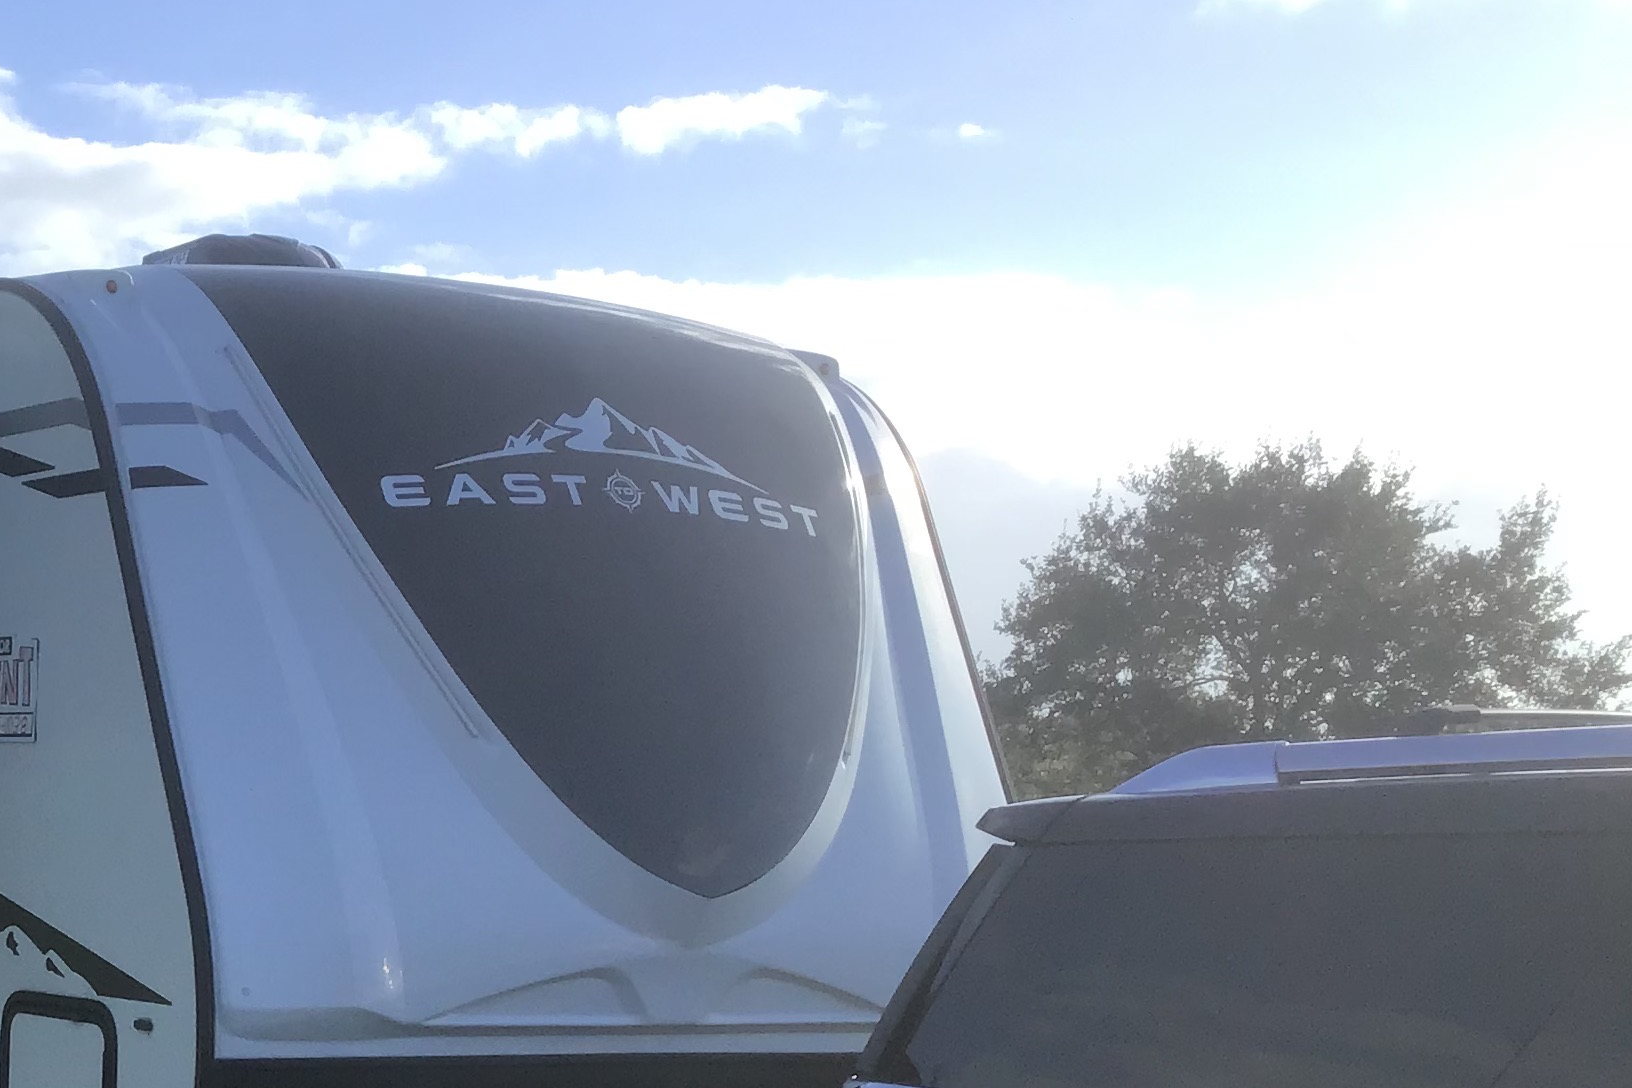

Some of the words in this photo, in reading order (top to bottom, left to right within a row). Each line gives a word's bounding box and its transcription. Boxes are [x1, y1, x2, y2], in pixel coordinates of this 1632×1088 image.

[380, 472, 587, 508] EAST
[614, 486, 634, 496] TO
[651, 480, 819, 538] WEST
